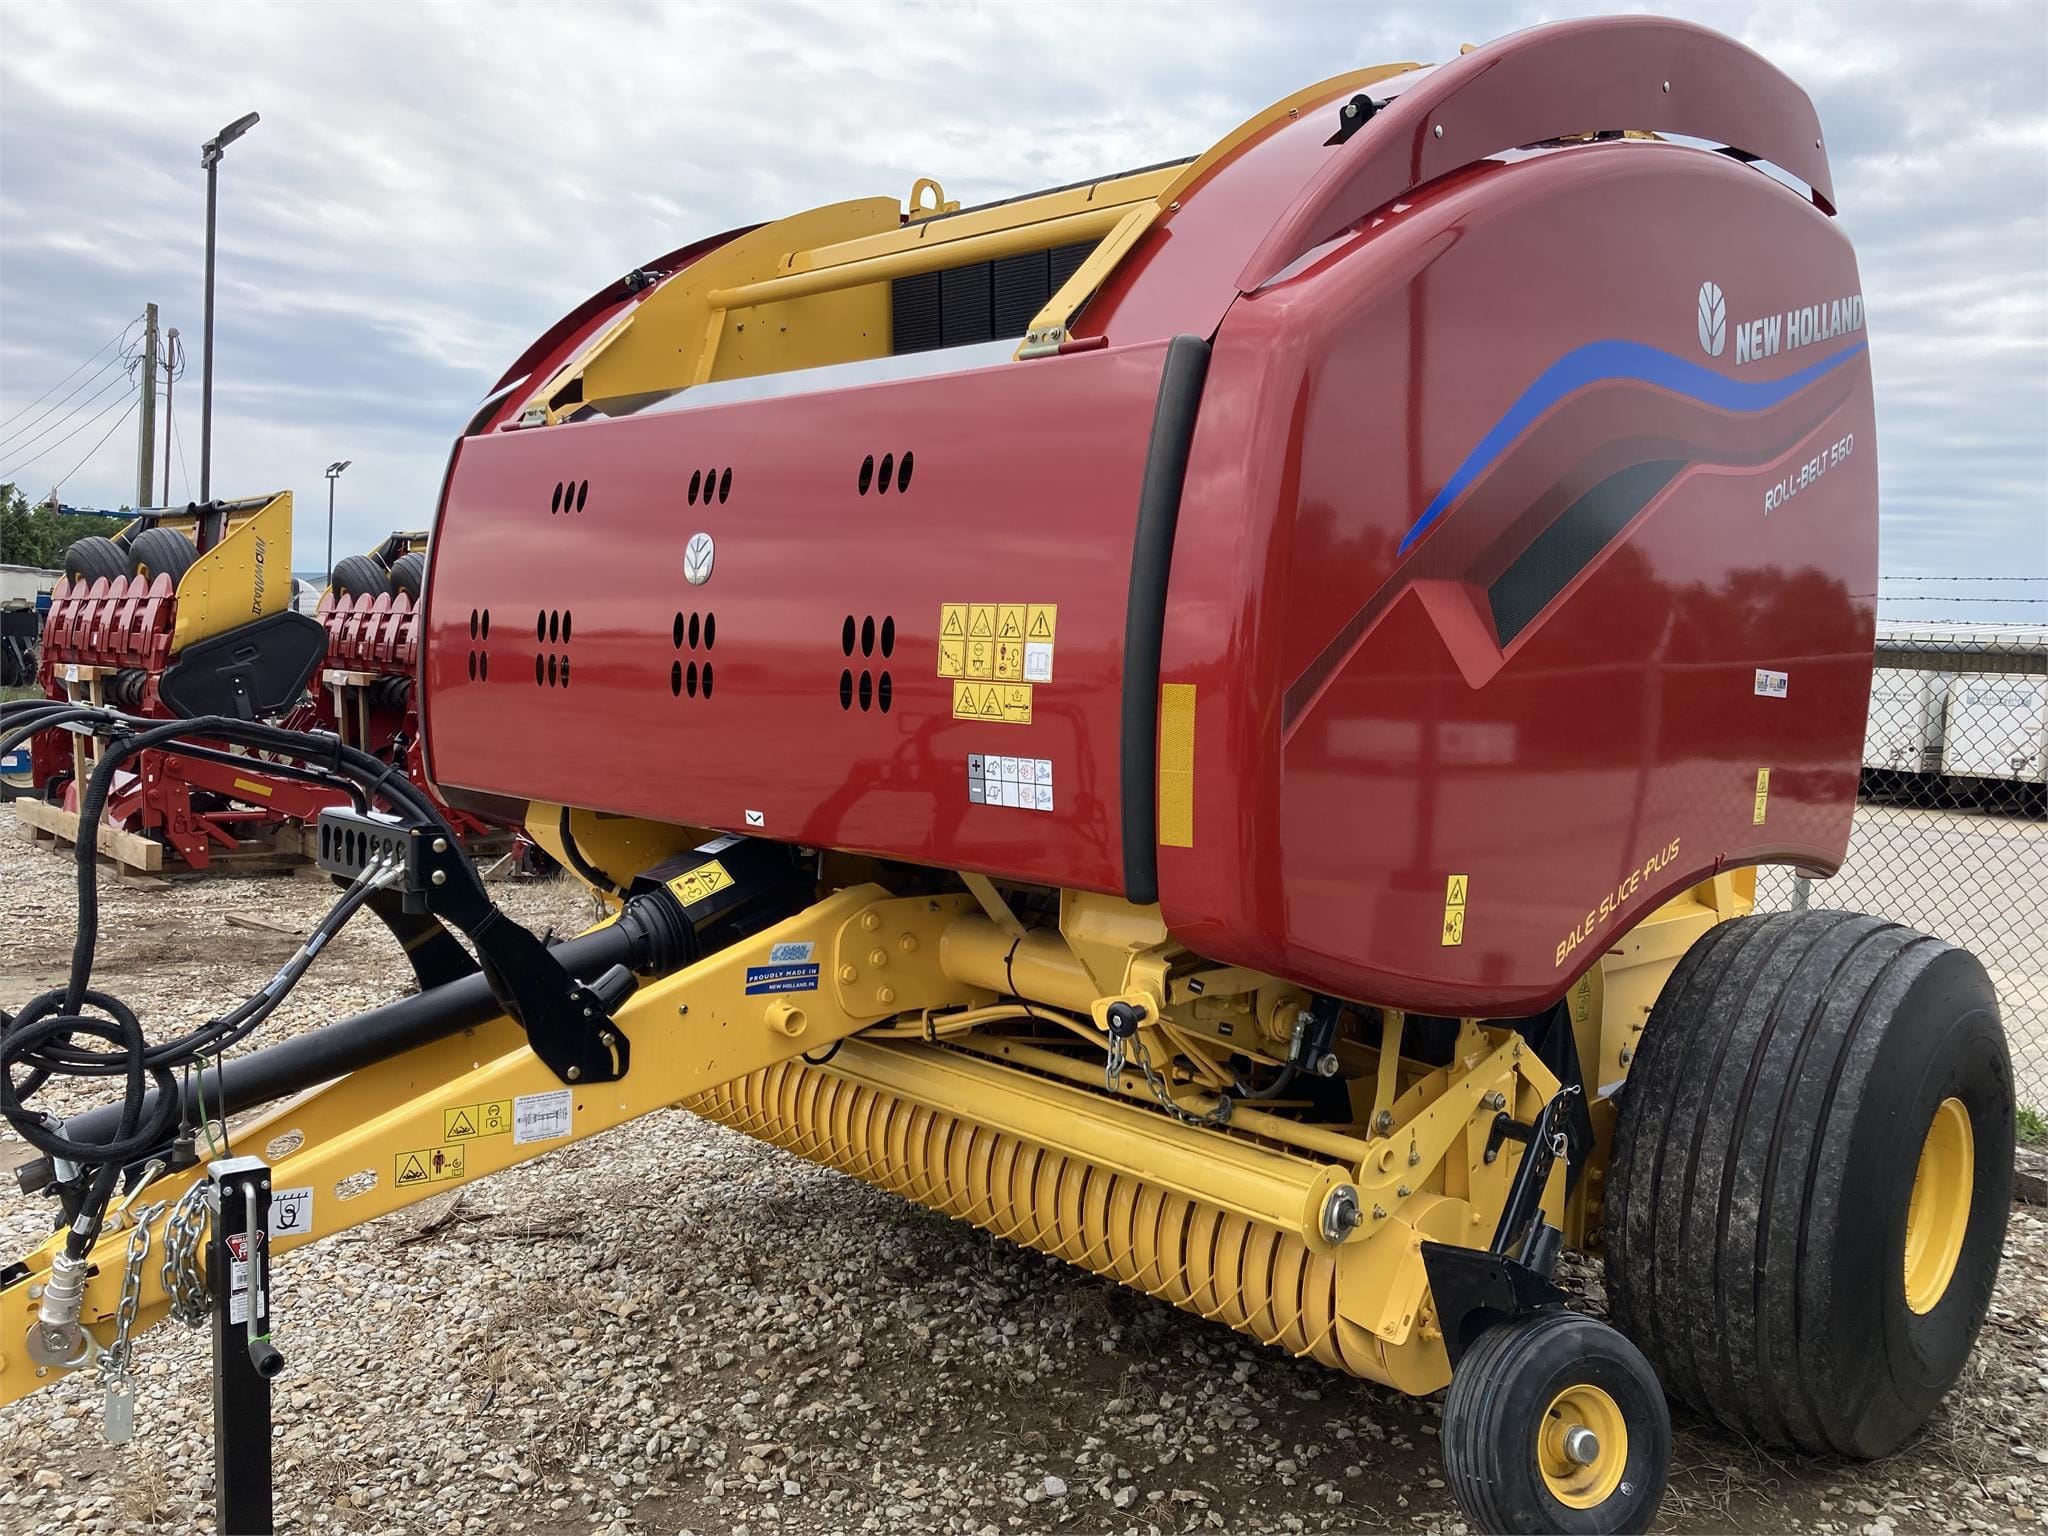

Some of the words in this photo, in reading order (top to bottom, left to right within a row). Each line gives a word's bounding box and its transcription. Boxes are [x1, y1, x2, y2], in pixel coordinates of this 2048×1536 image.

[1736, 314, 1782, 366] NEW
[1786, 295, 1864, 351] HOLLAND
[1764, 449, 1829, 517] ROLL-BELT
[1830, 433, 1854, 468] 560
[1555, 910, 1596, 968] BALE
[1598, 869, 1641, 923] SLICE
[1643, 837, 1681, 881] PLUS
[748, 971, 783, 982] PROUDLY
[786, 969, 806, 977] MADE
